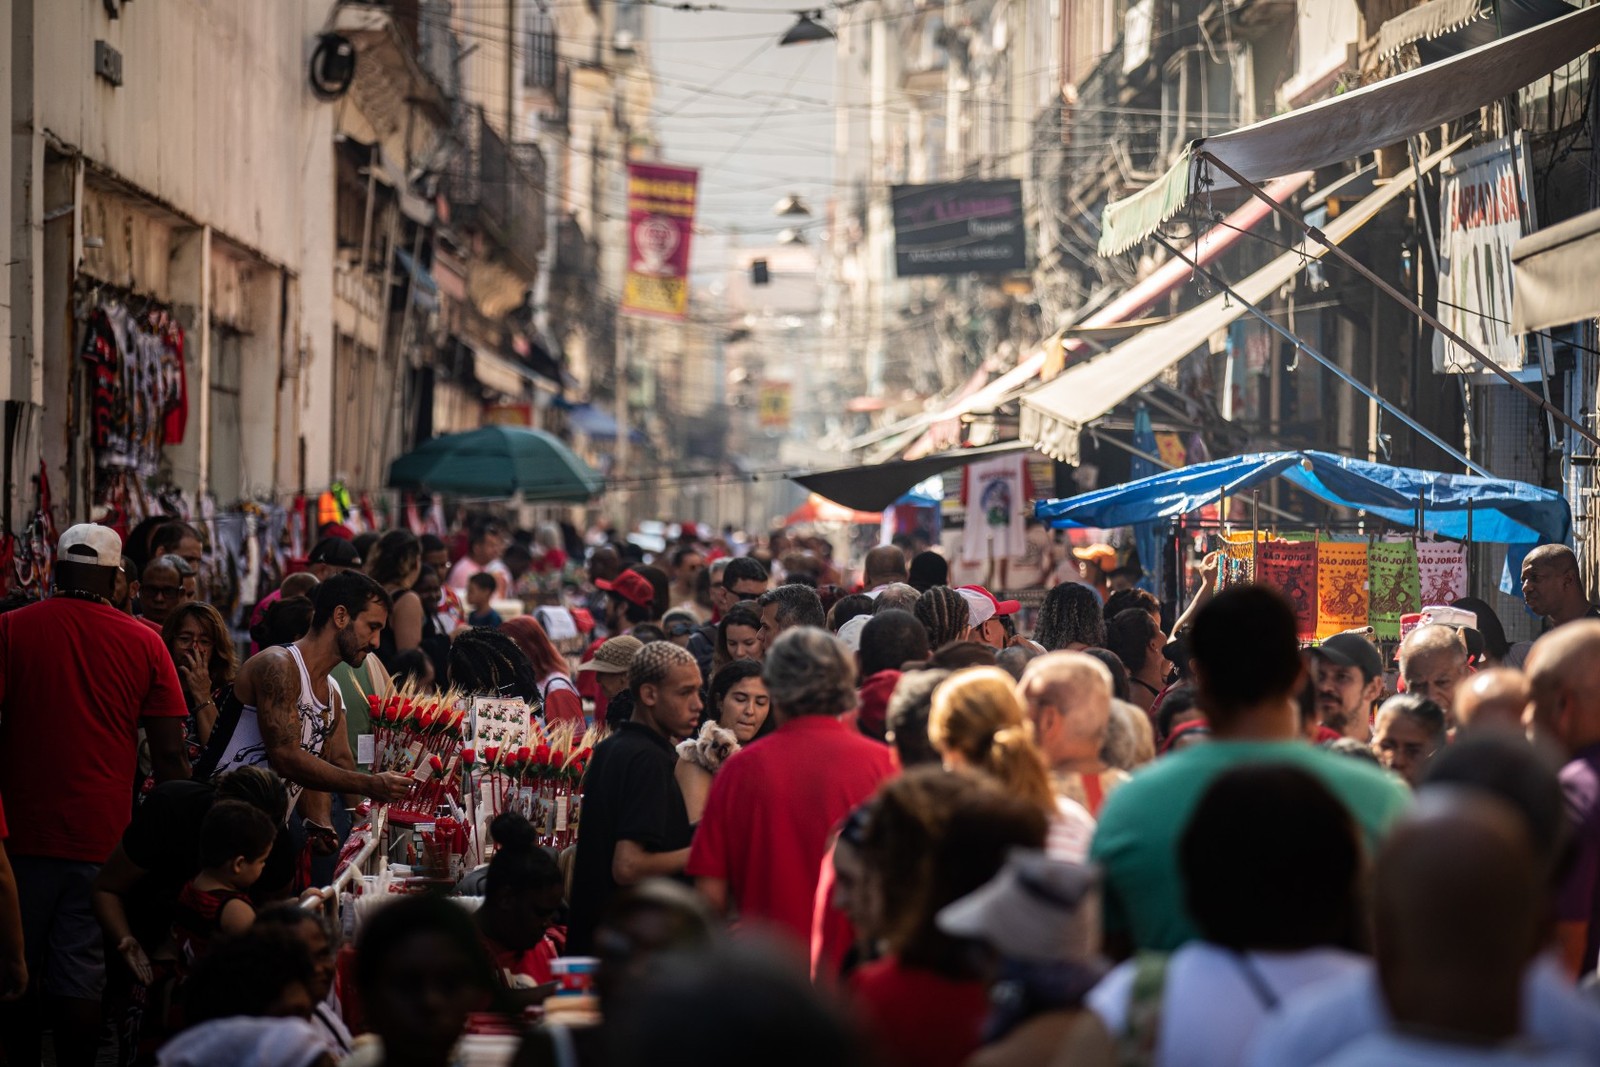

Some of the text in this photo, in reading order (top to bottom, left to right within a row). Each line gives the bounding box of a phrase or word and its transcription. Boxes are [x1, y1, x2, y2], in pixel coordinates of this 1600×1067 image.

[1282, 553, 1312, 561] JORGE
[1319, 556, 1368, 566] SÃO JORGE
[1370, 554, 1389, 563] SÃO
[1417, 555, 1463, 564] SÃO JORGE
